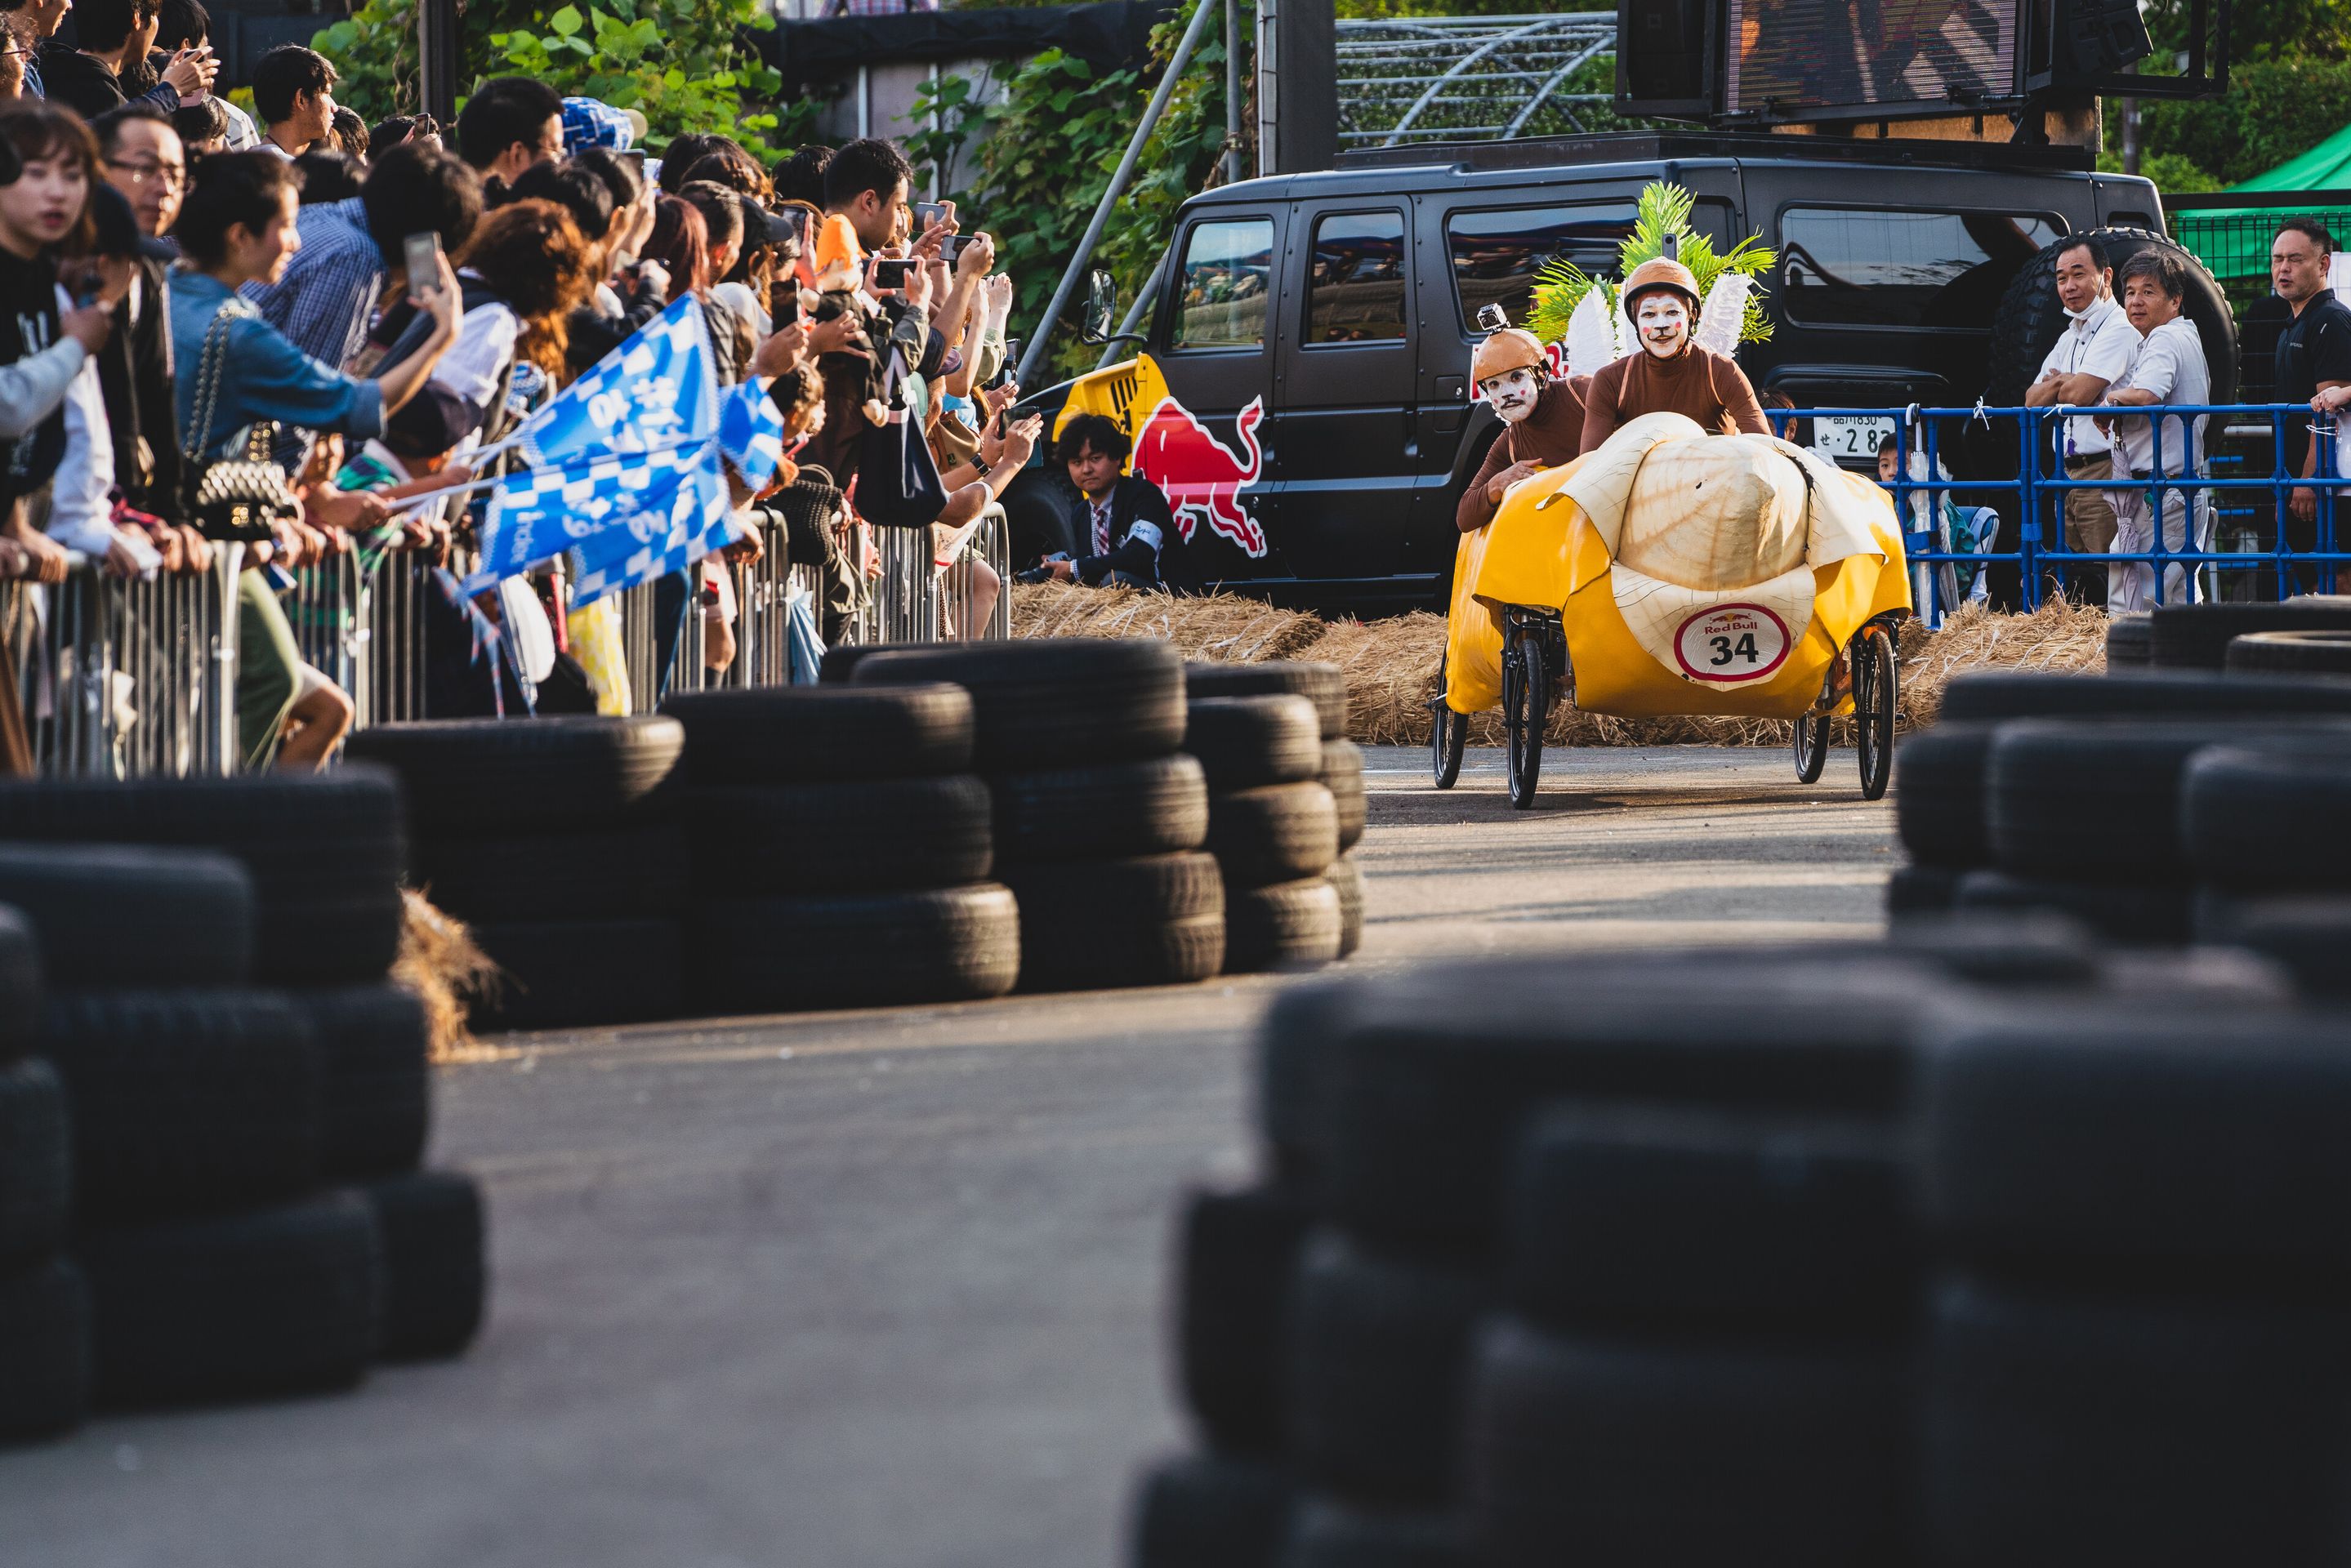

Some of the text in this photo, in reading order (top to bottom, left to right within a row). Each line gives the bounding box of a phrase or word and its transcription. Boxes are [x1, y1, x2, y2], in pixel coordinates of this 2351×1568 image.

[1820, 434, 1830, 445] せ
[1705, 621, 1758, 635] Red Bull
[1710, 633, 1759, 666] 34
